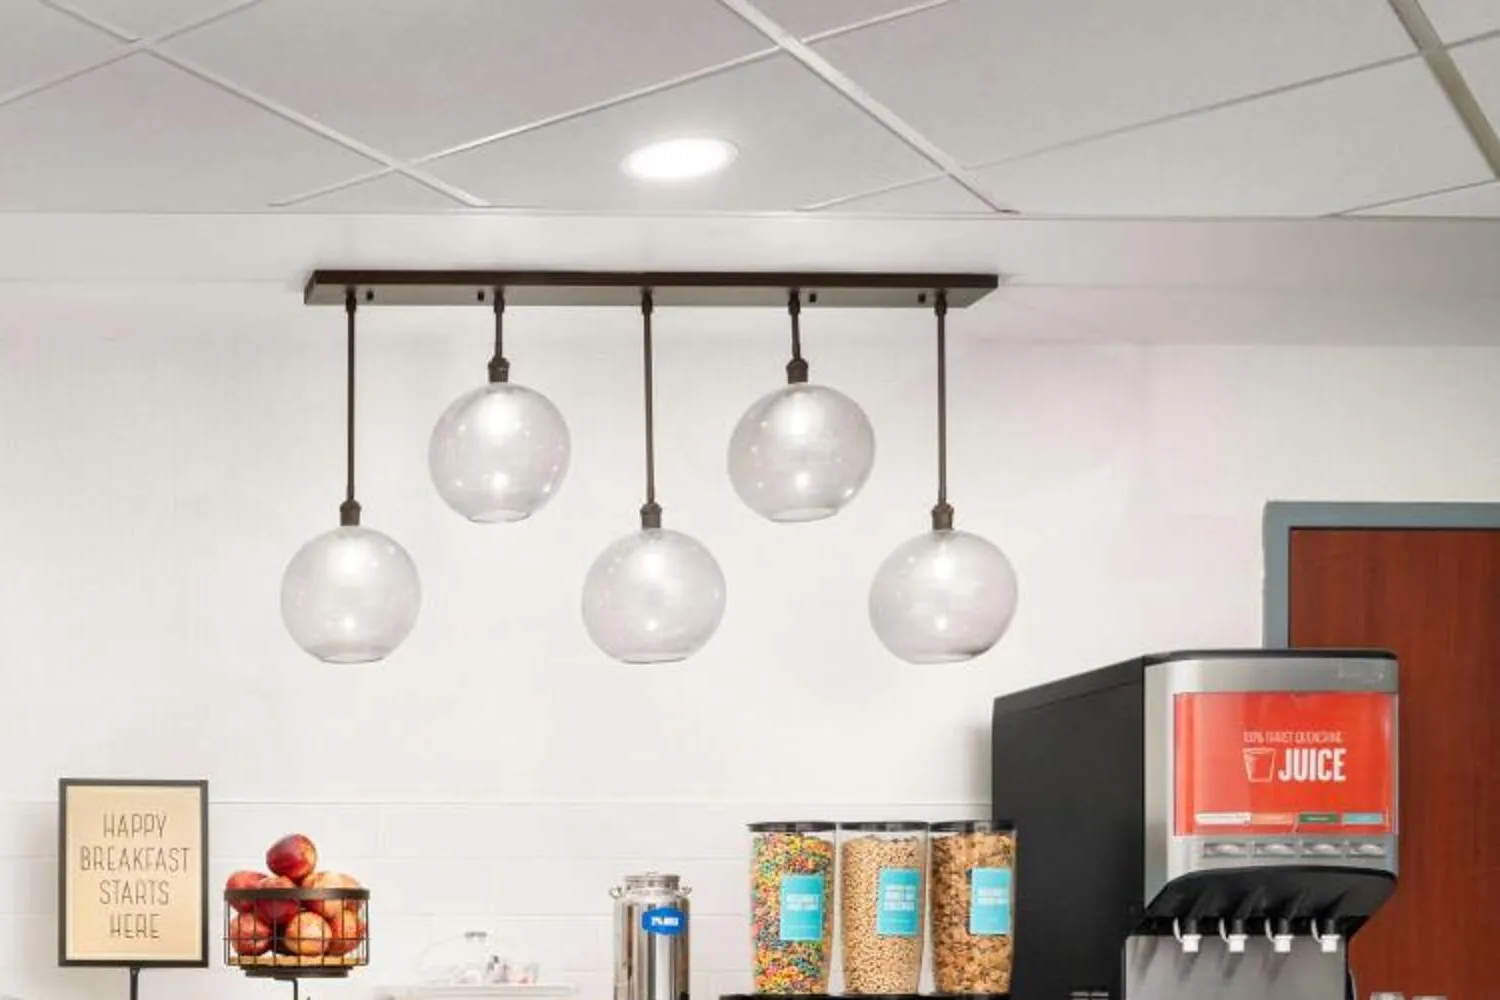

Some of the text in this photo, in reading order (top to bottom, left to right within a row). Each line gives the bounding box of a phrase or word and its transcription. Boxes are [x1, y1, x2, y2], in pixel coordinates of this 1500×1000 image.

[1277, 747, 1348, 782] JUICE
[103, 813, 167, 839] HAPPY
[80, 846, 190, 872] BREAKFAST
[99, 879, 170, 905] STARTS
[109, 913, 161, 939] HERE
